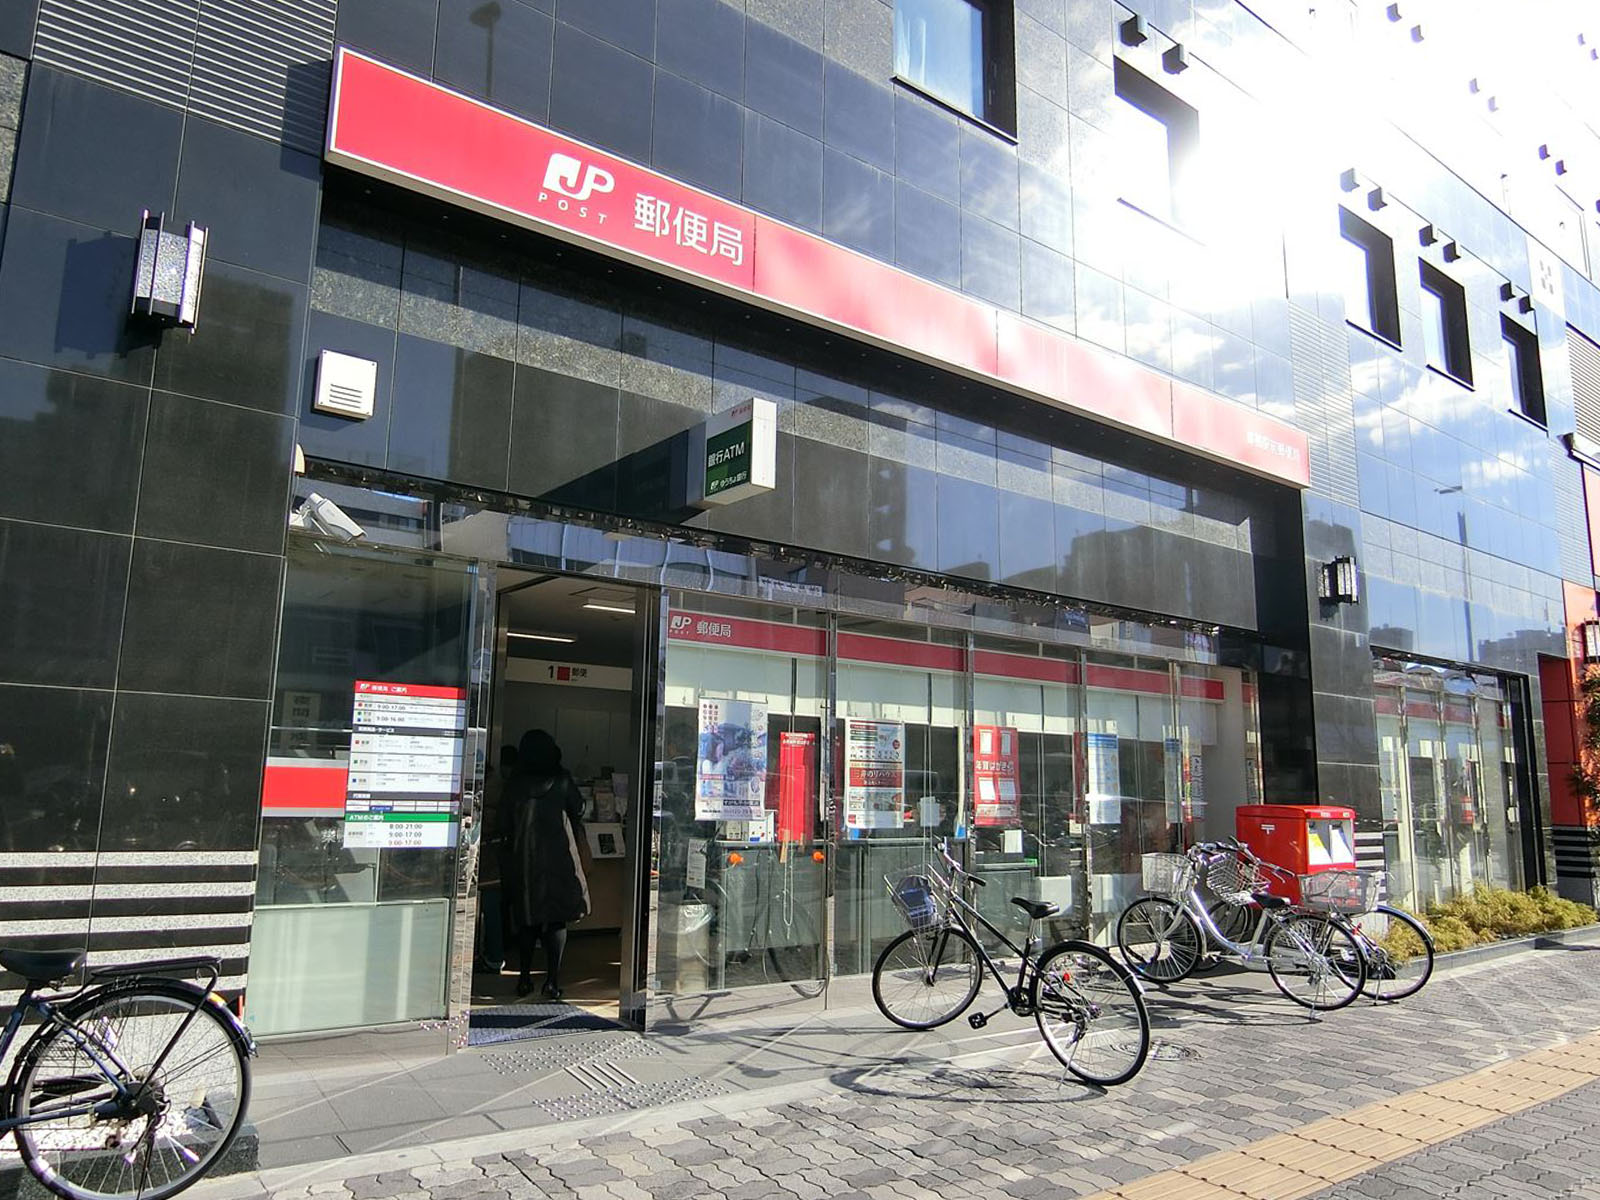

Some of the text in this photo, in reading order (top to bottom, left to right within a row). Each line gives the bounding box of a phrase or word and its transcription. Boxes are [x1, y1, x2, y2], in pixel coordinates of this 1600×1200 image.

[538, 192, 607, 224] POST
[634, 193, 743, 266] 郵便局
[707, 441, 745, 468] 銀行ATM
[696, 620, 732, 638] 郵便局
[547, 665, 554, 678] 1
